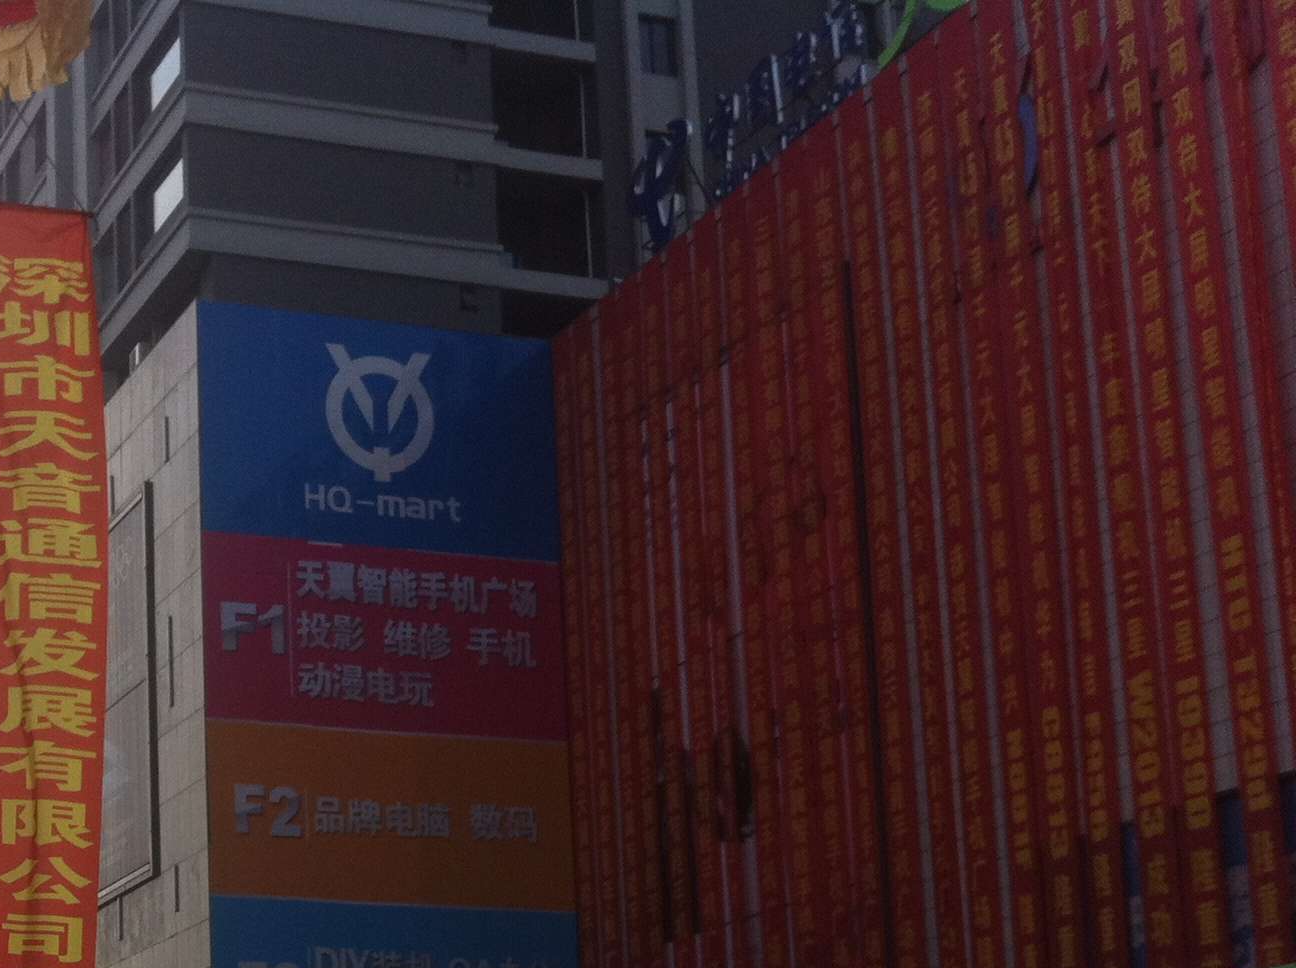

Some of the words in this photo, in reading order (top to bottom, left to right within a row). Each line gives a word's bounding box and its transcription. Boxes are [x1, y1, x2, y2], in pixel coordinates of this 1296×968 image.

[304, 482, 462, 523] HQ-mart
[295, 560, 537, 619] 天翼智能手机广场
[219, 599, 286, 655] F1
[297, 613, 365, 652] 投影
[383, 621, 451, 660] 维修
[466, 628, 537, 669] 手机
[297, 663, 434, 707] 动漫电玩
[232, 783, 303, 838] F2
[314, 795, 451, 838] 品牌电脑
[470, 804, 538, 843] 数码
